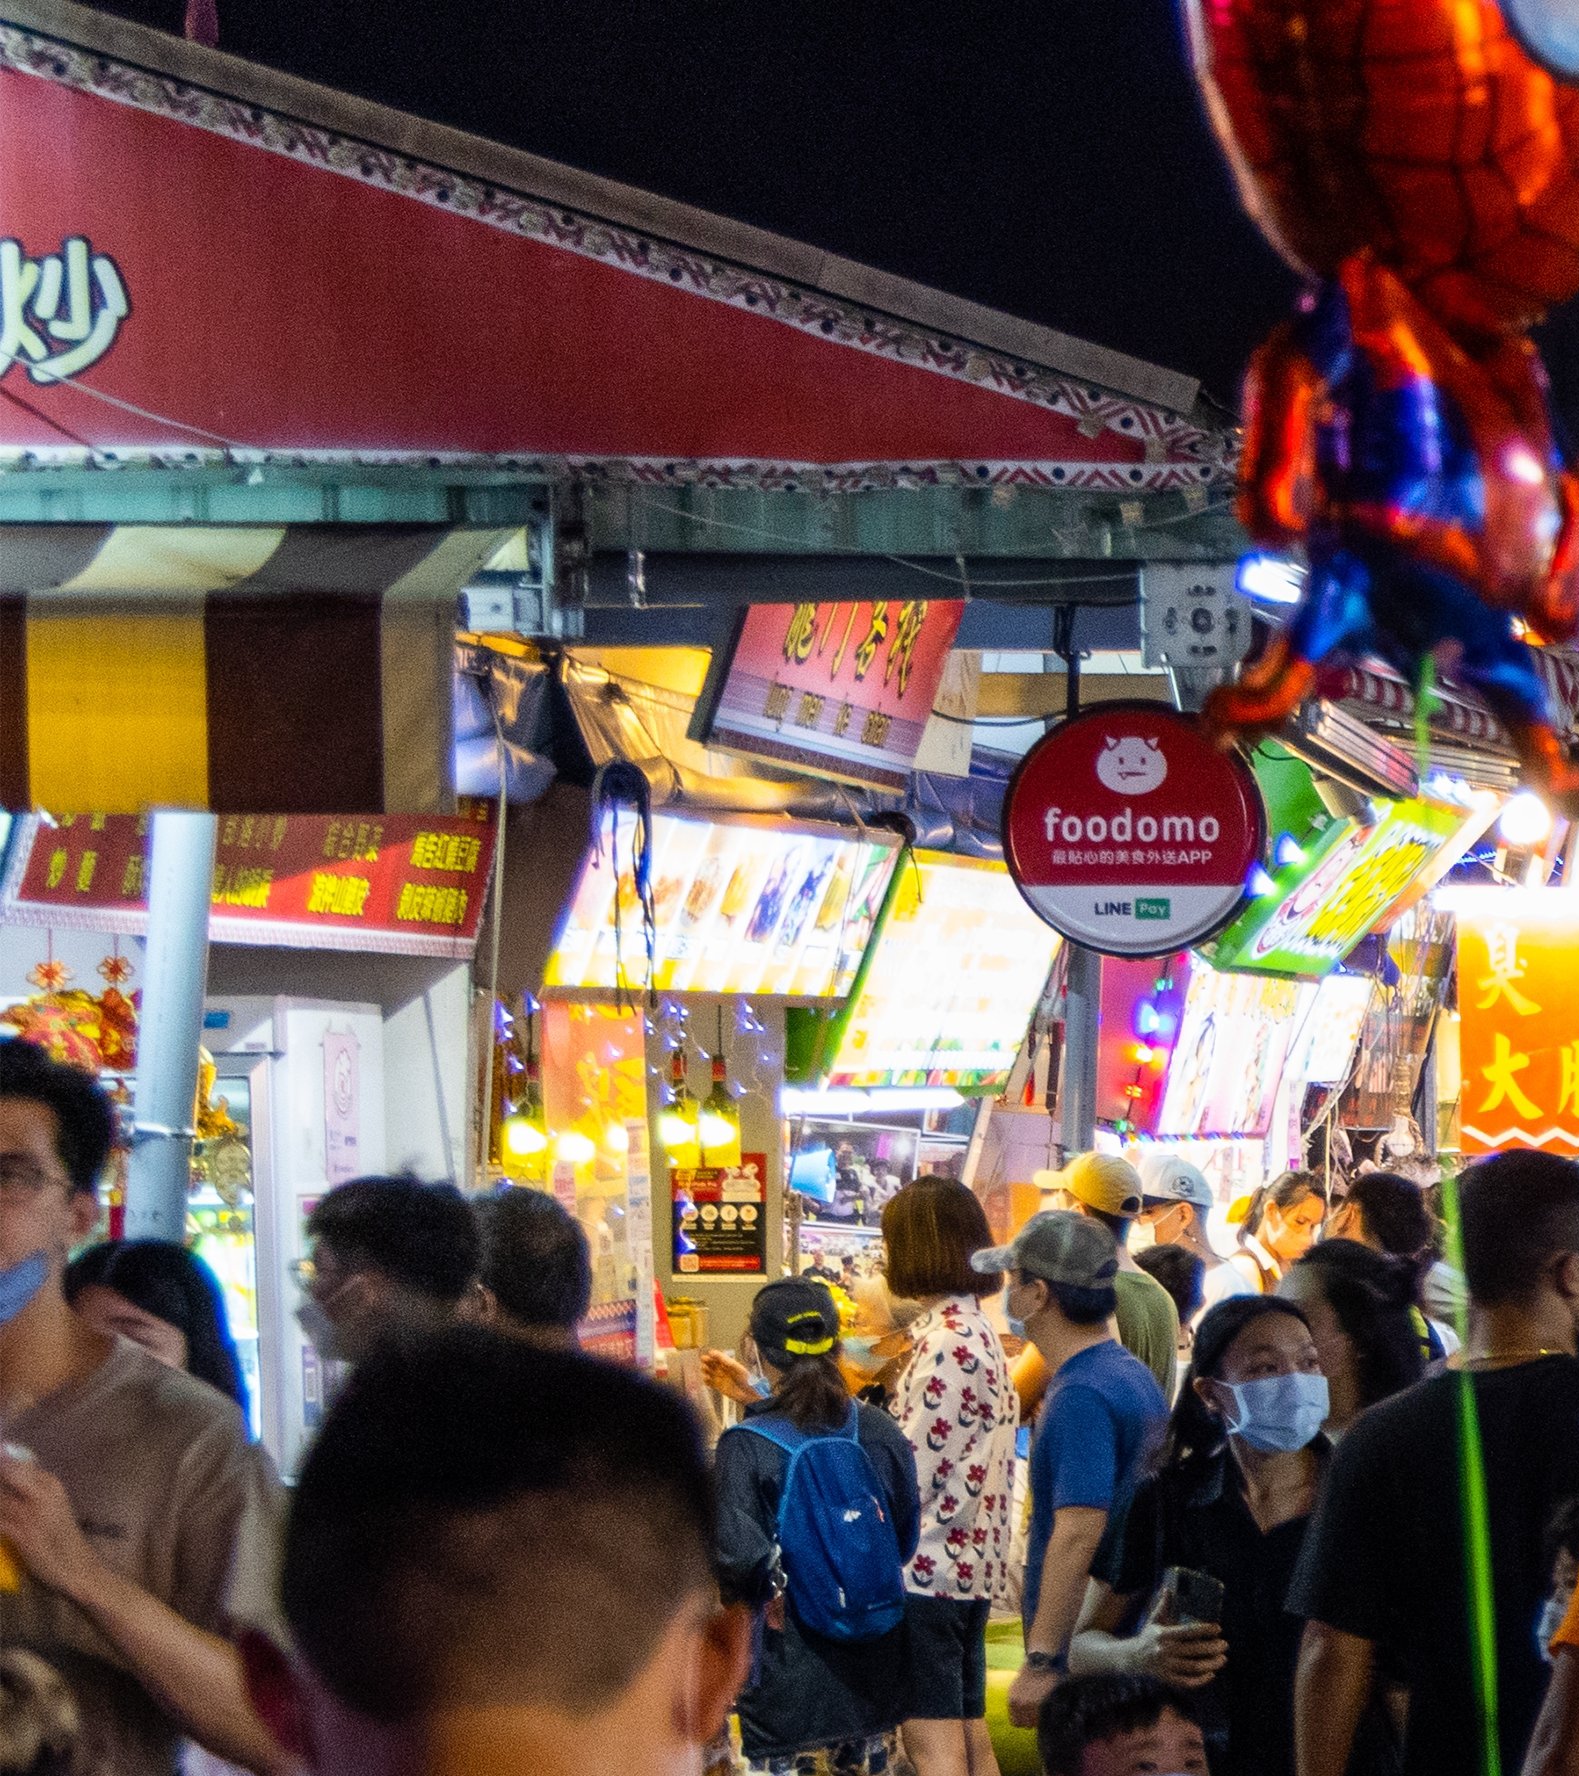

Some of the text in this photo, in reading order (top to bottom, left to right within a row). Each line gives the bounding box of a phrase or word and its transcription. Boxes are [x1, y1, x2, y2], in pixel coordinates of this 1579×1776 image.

[1044, 806, 1220, 843] foodomo
[1052, 849, 1213, 866] 最貼心的美食外送APP
[1094, 902, 1168, 917] LINE Pay
